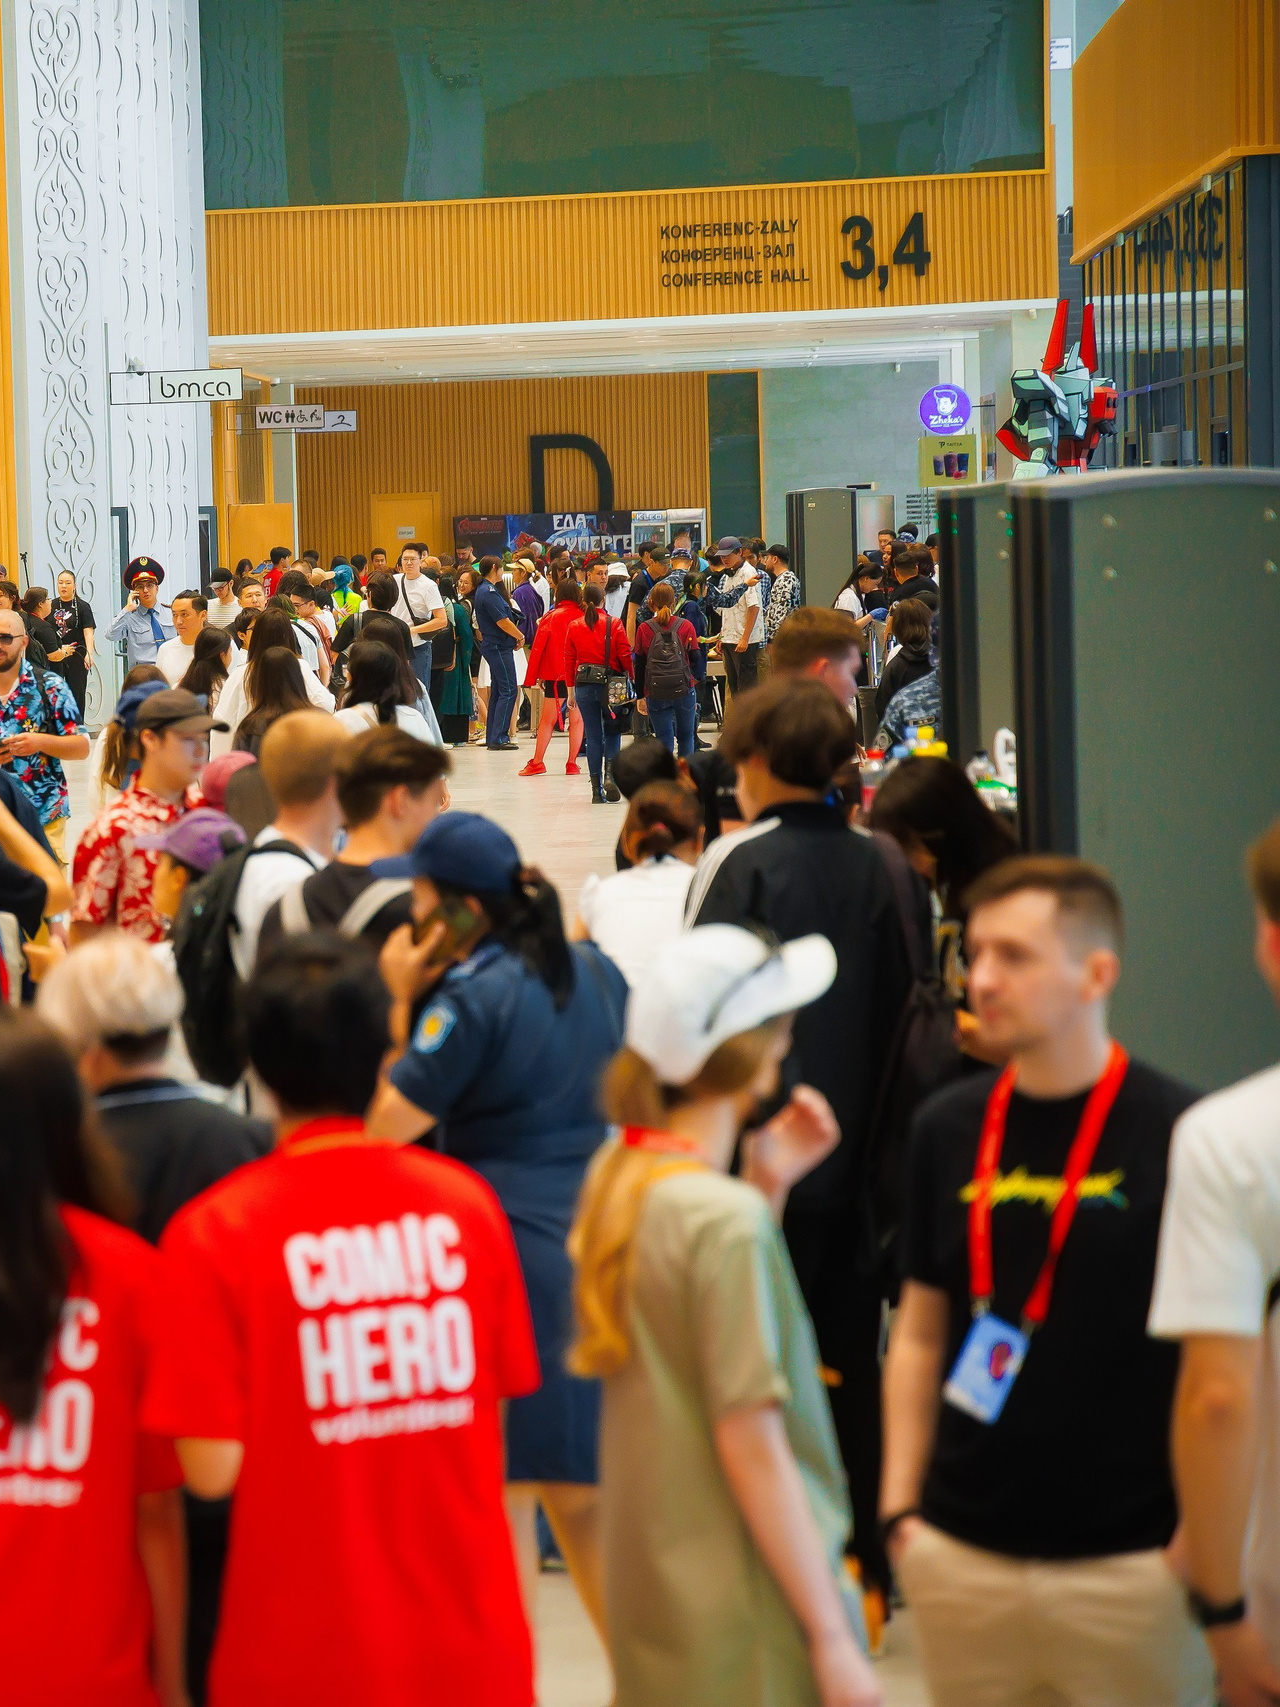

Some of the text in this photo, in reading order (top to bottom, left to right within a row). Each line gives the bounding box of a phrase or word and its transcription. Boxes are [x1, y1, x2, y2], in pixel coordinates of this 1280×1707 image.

[660, 218, 799, 240] KONFERENC-ZALY
[840, 211, 932, 292] 3,4
[661, 267, 810, 288] CONFERENCE HALL
[160, 376, 231, 399] bmca
[258, 410, 282, 424] WC
[928, 414, 964, 425] Zheka's
[552, 513, 587, 531] ЕДА
[297, 1294, 477, 1412] HERO
